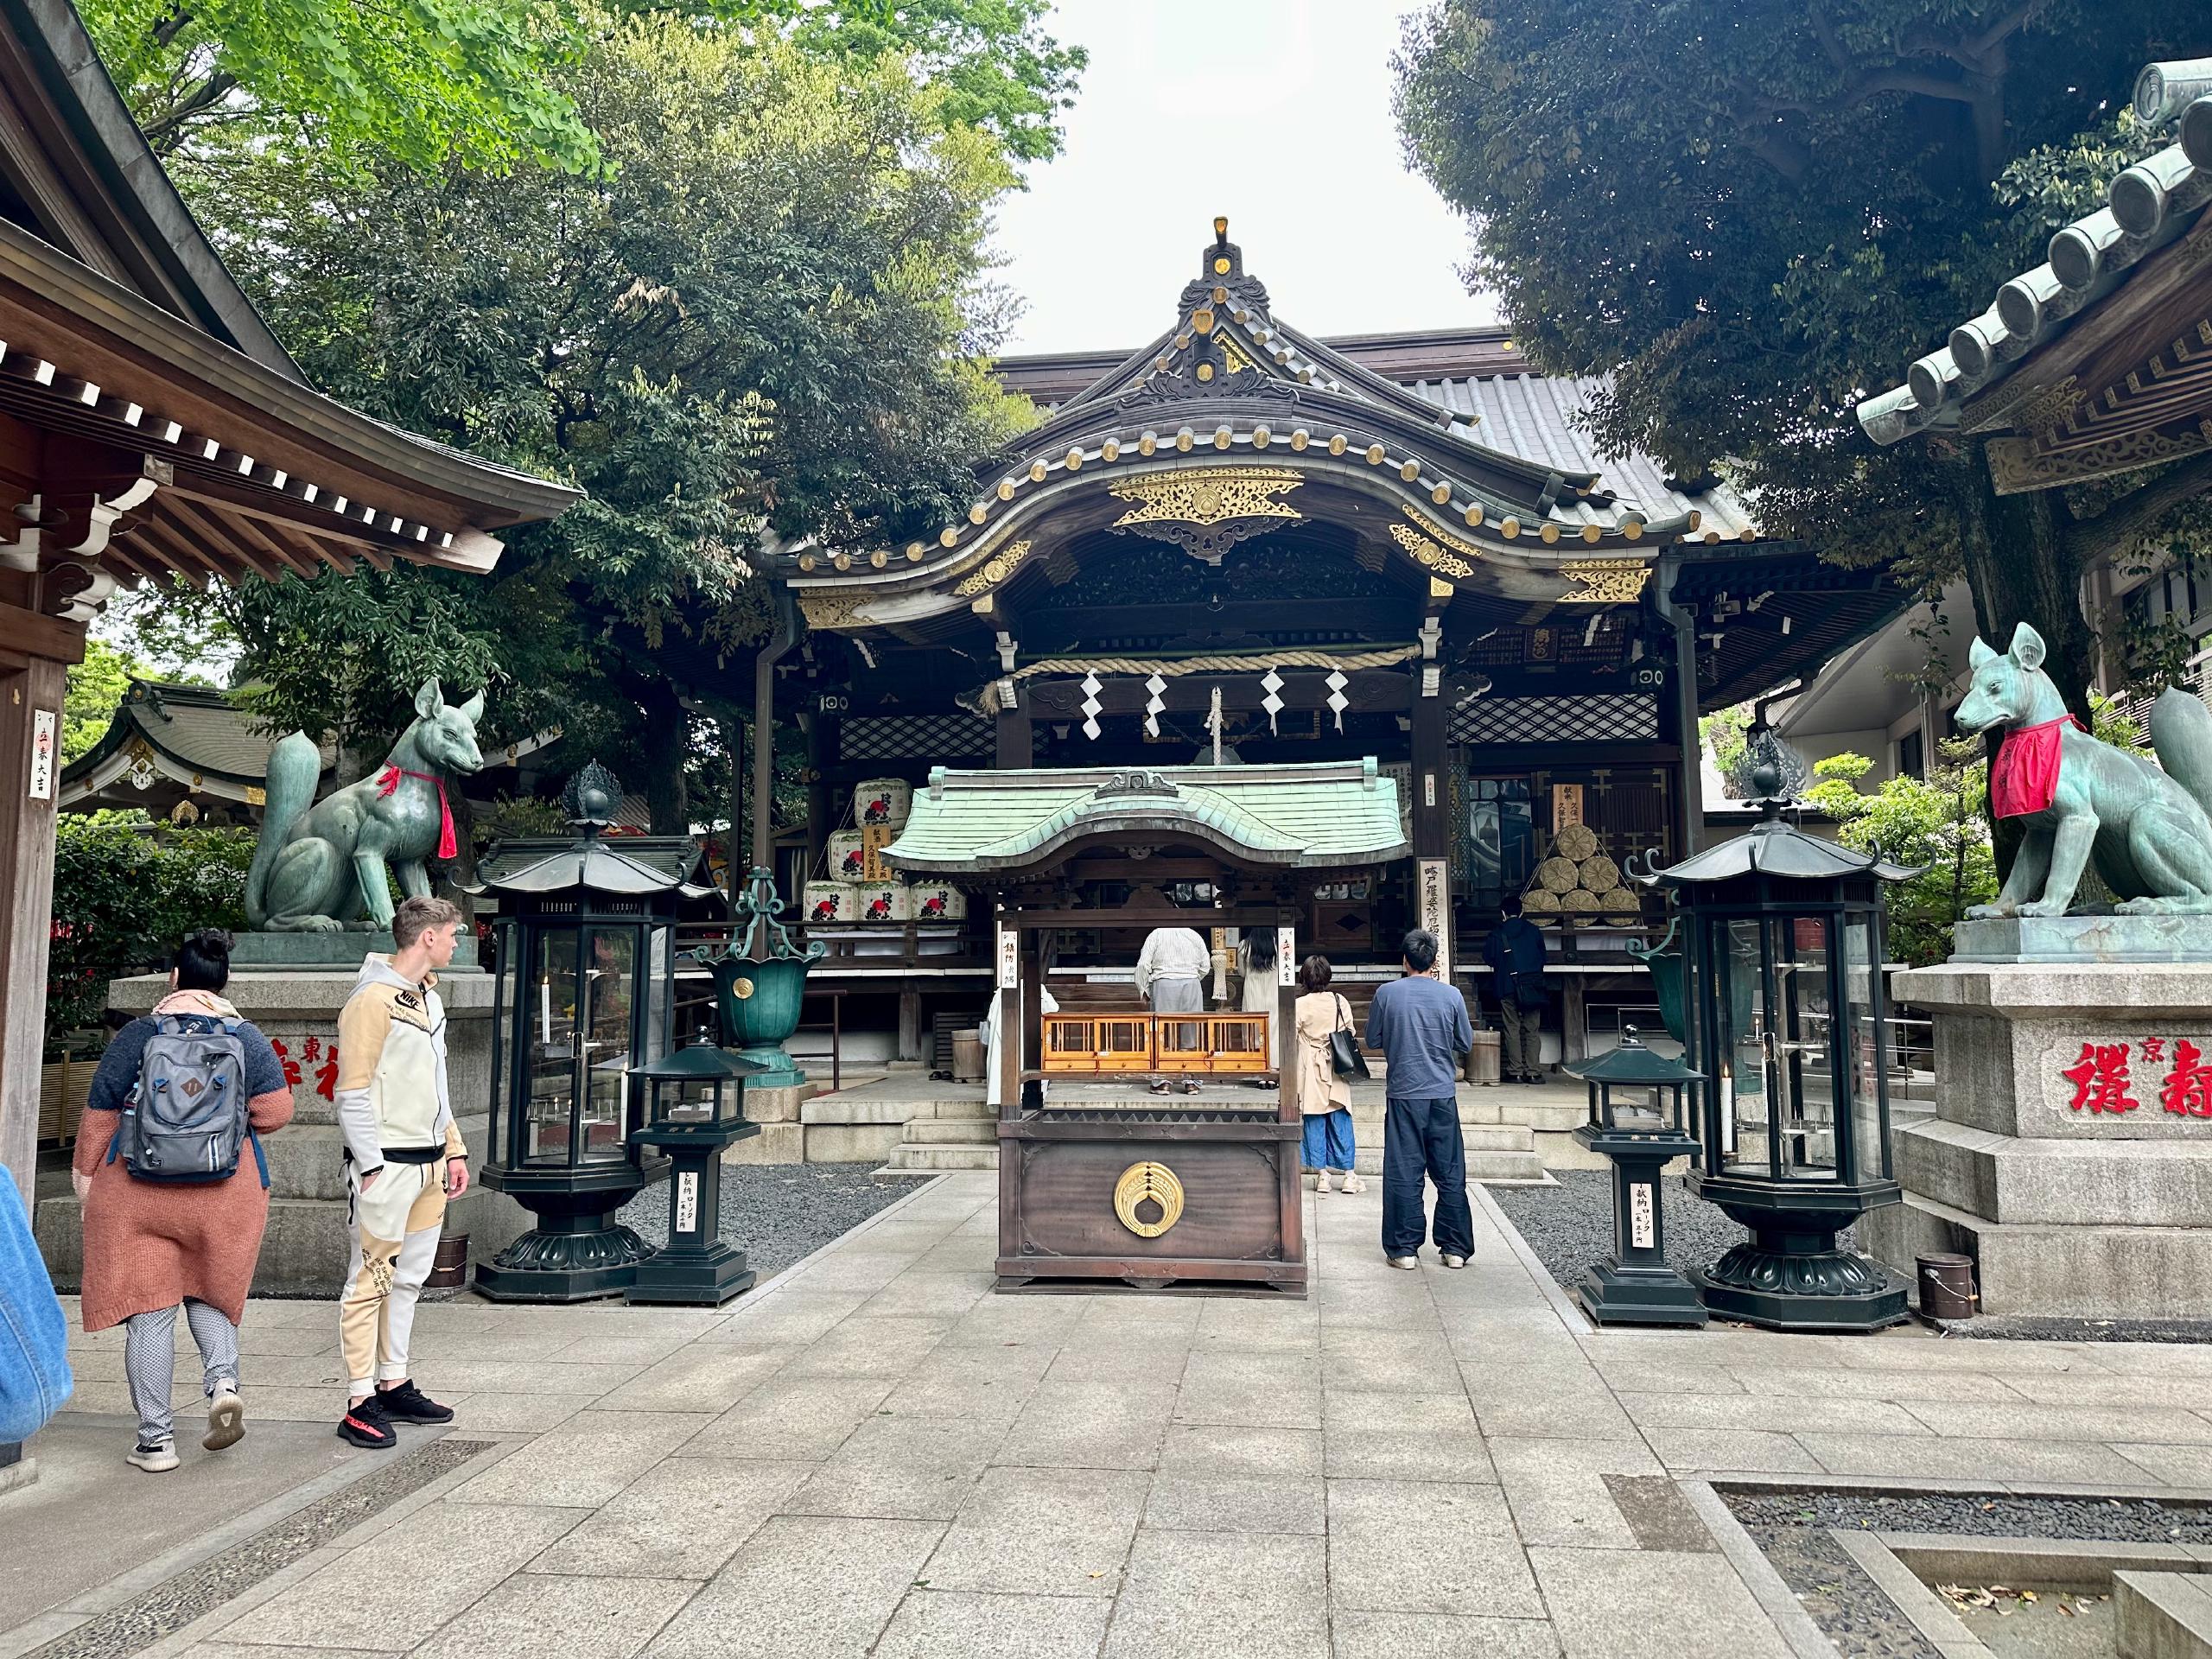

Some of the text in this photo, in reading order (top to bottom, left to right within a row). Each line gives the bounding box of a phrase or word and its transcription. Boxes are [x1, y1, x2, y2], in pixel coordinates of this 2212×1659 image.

[37, 728, 48, 791] 立春大吉
[400, 990, 420, 1007] NIKE
[301, 1037, 321, 1063] 東
[2139, 1037, 2165, 1062] 京
